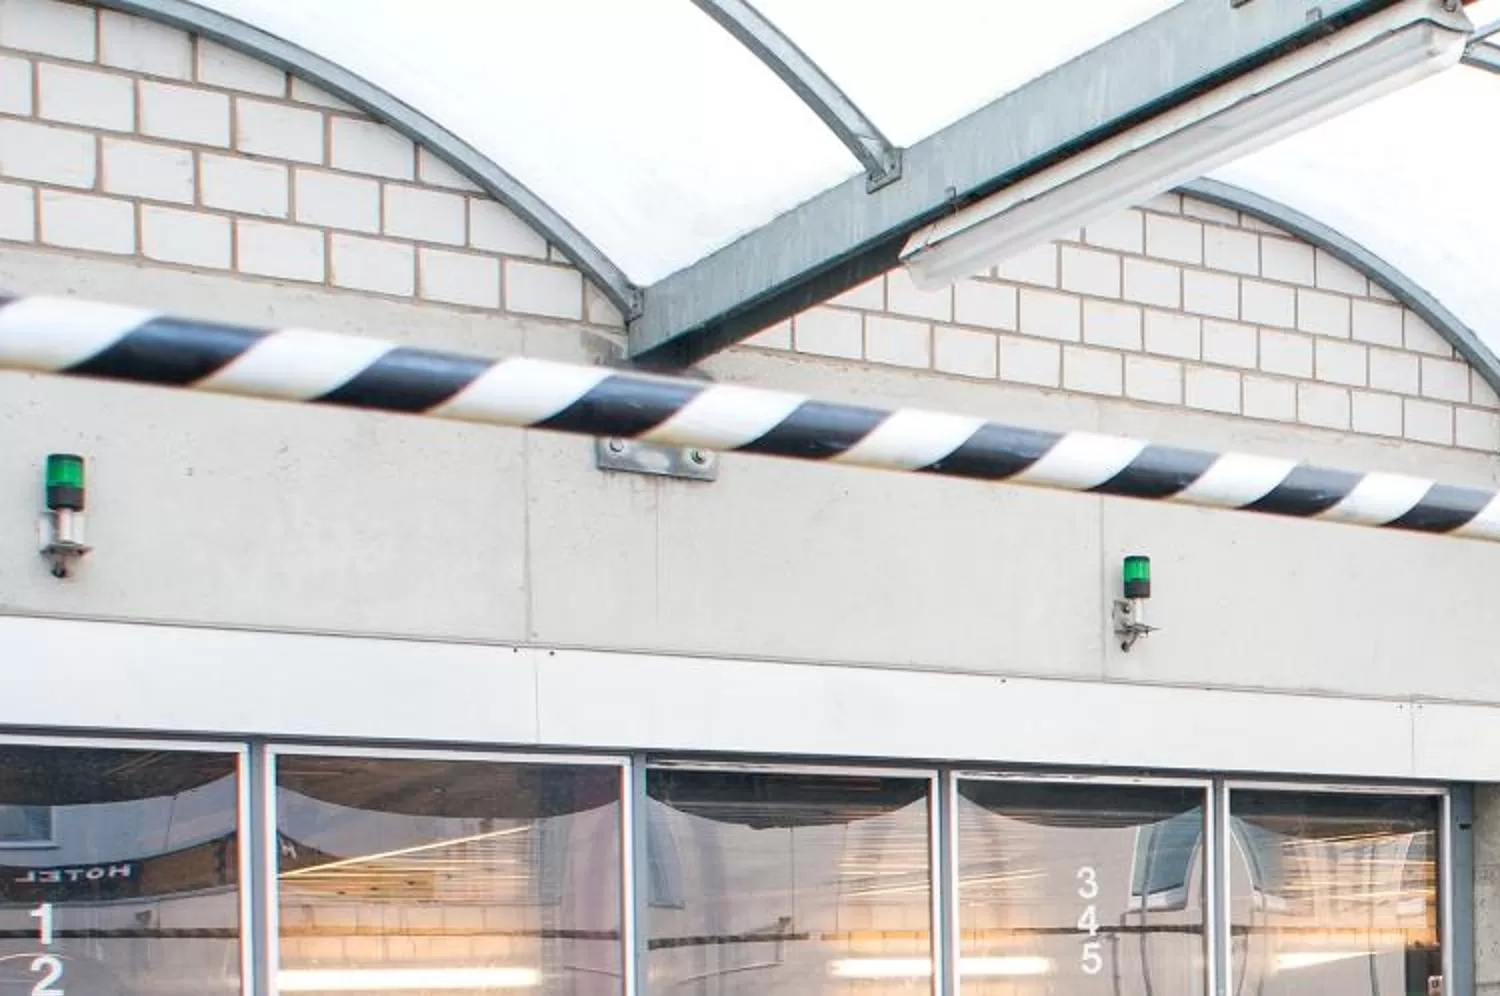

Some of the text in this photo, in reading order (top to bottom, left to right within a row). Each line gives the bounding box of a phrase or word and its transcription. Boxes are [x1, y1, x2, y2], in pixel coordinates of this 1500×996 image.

[1076, 865, 1099, 899] 3
[28, 902, 53, 945] 1
[1077, 905, 1100, 936] 4
[1080, 942, 1103, 975] 5
